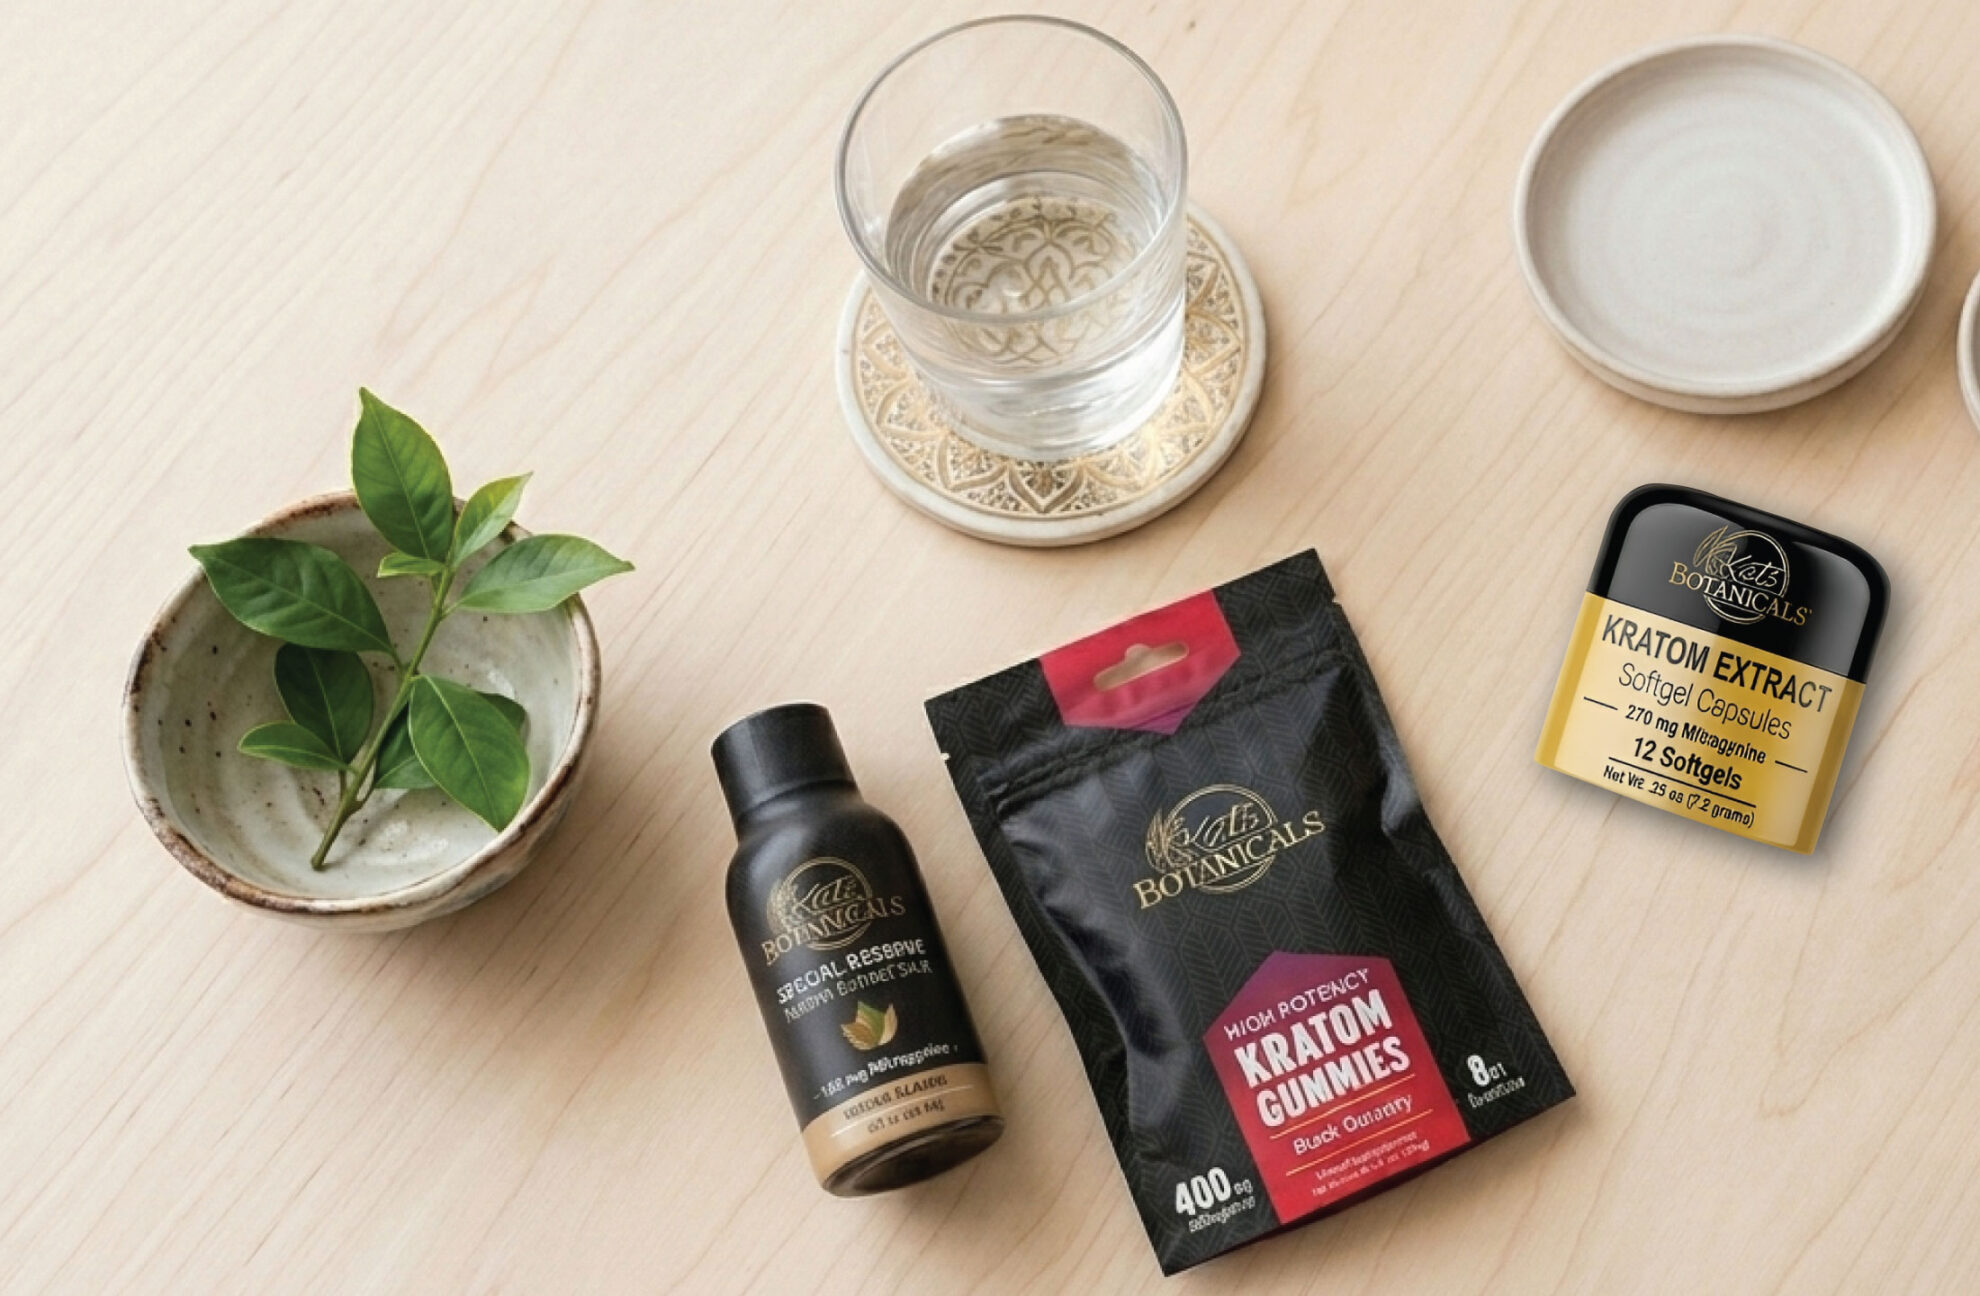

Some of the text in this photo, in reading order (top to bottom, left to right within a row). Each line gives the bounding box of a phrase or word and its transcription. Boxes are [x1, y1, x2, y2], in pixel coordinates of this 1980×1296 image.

[1602, 614, 1832, 712] KRATOM EXTRACT
[1618, 662, 1792, 740] Softgel Capsules
[1625, 704, 1653, 725] 270
[1655, 717, 1678, 738] mg
[1634, 737, 1743, 790] 12 Softgels
[1133, 810, 1326, 910] BOTANICALS
[1234, 988, 1393, 1089] KRATOM
[1467, 1054, 1491, 1087] 8
[1256, 1036, 1411, 1127] GUMMIES
[1176, 1167, 1231, 1216] 400
